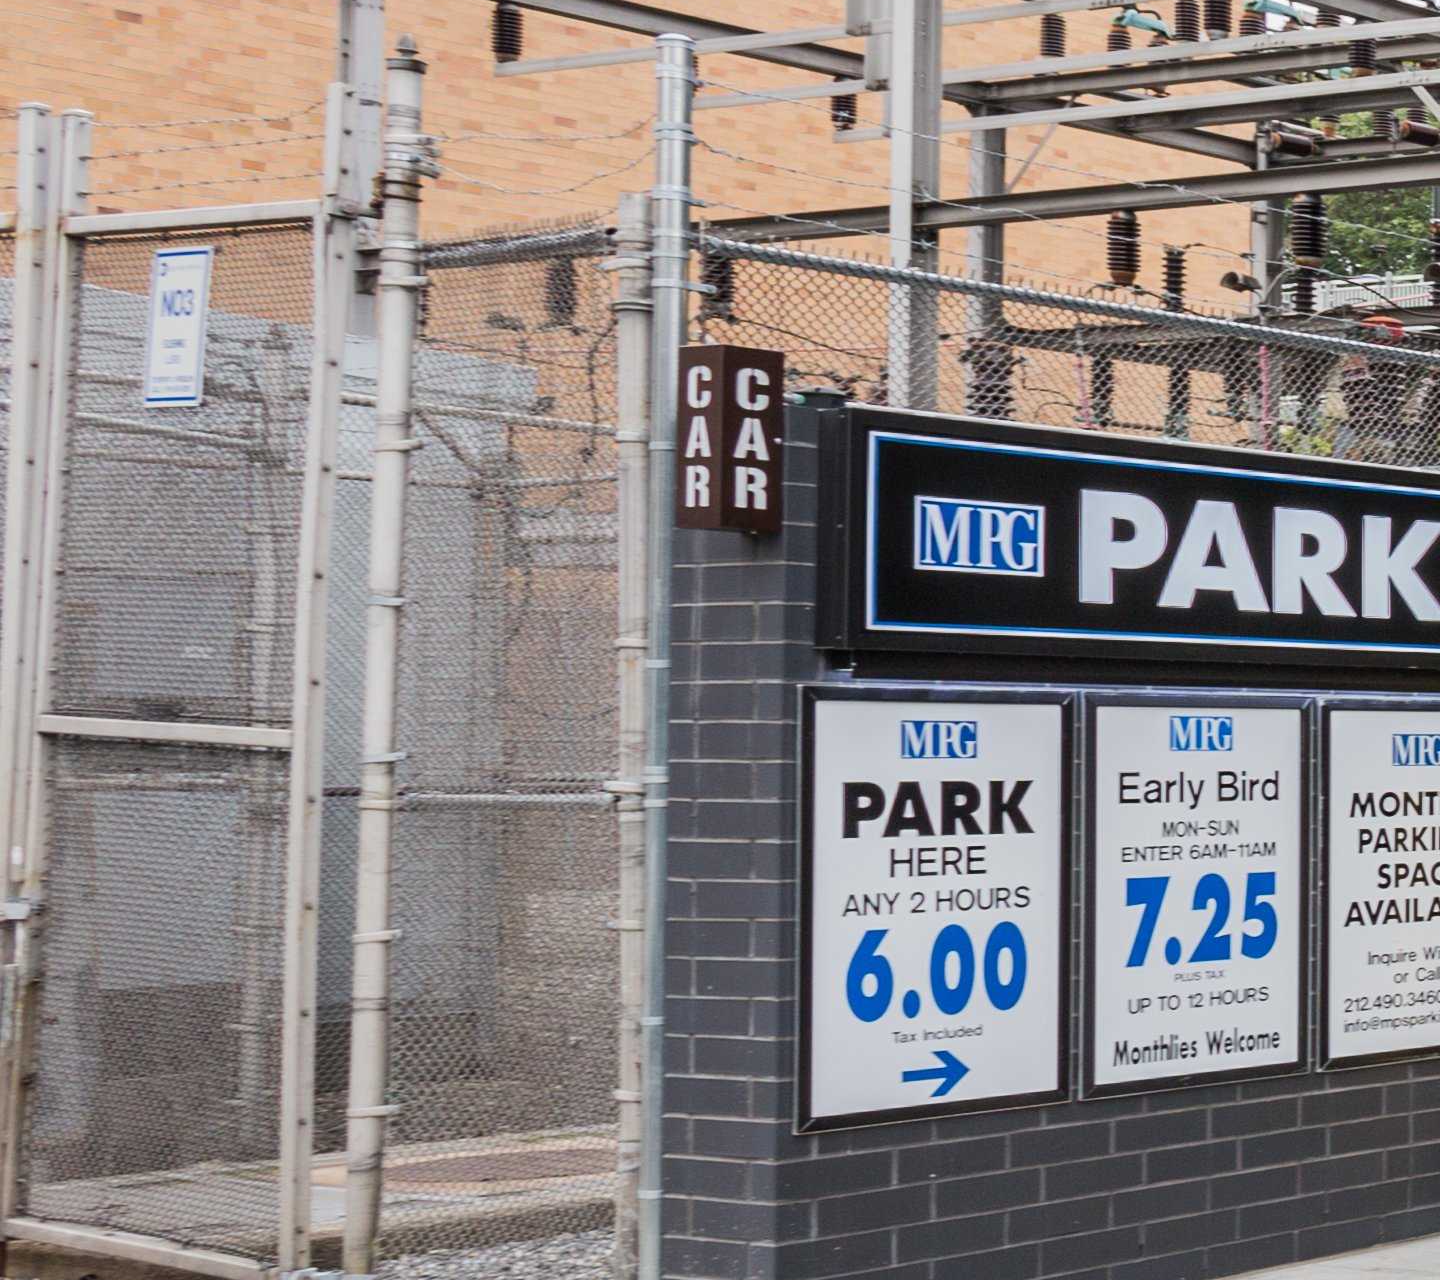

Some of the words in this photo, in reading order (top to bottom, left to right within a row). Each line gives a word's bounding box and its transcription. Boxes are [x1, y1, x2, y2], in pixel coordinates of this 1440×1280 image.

[685, 365, 712, 508] CAR
[733, 368, 770, 510] CAR
[917, 500, 1043, 575] MPG
[902, 721, 977, 758] MPG
[1171, 716, 1232, 751] MPG
[1119, 771, 1204, 809] Early
[1217, 770, 1279, 802] Bird
[842, 780, 1034, 839] PARK
[1162, 820, 1239, 837] MON-SUN
[890, 846, 987, 878] HERE
[1121, 845, 1182, 862] ENTER
[1189, 842, 1276, 859] 6AM-11AM
[843, 893, 899, 917] ANY
[911, 892, 925, 913] 2
[936, 886, 1030, 912] HOURS
[1124, 871, 1278, 967] 7.25
[846, 921, 1026, 1023] 6.00
[1368, 950, 1416, 966] Inquire
[1174, 971, 1201, 982] PLUS
[1393, 972, 1409, 983] or
[1128, 997, 1151, 1014] UP
[1158, 995, 1180, 1011] TO
[1187, 993, 1203, 1008] 12
[1210, 986, 1269, 1007] HOURS
[891, 1031, 917, 1044] Tax
[923, 1024, 983, 1041] Included
[1113, 1034, 1197, 1066] Monthlies
[1205, 1028, 1280, 1055] Welcome
